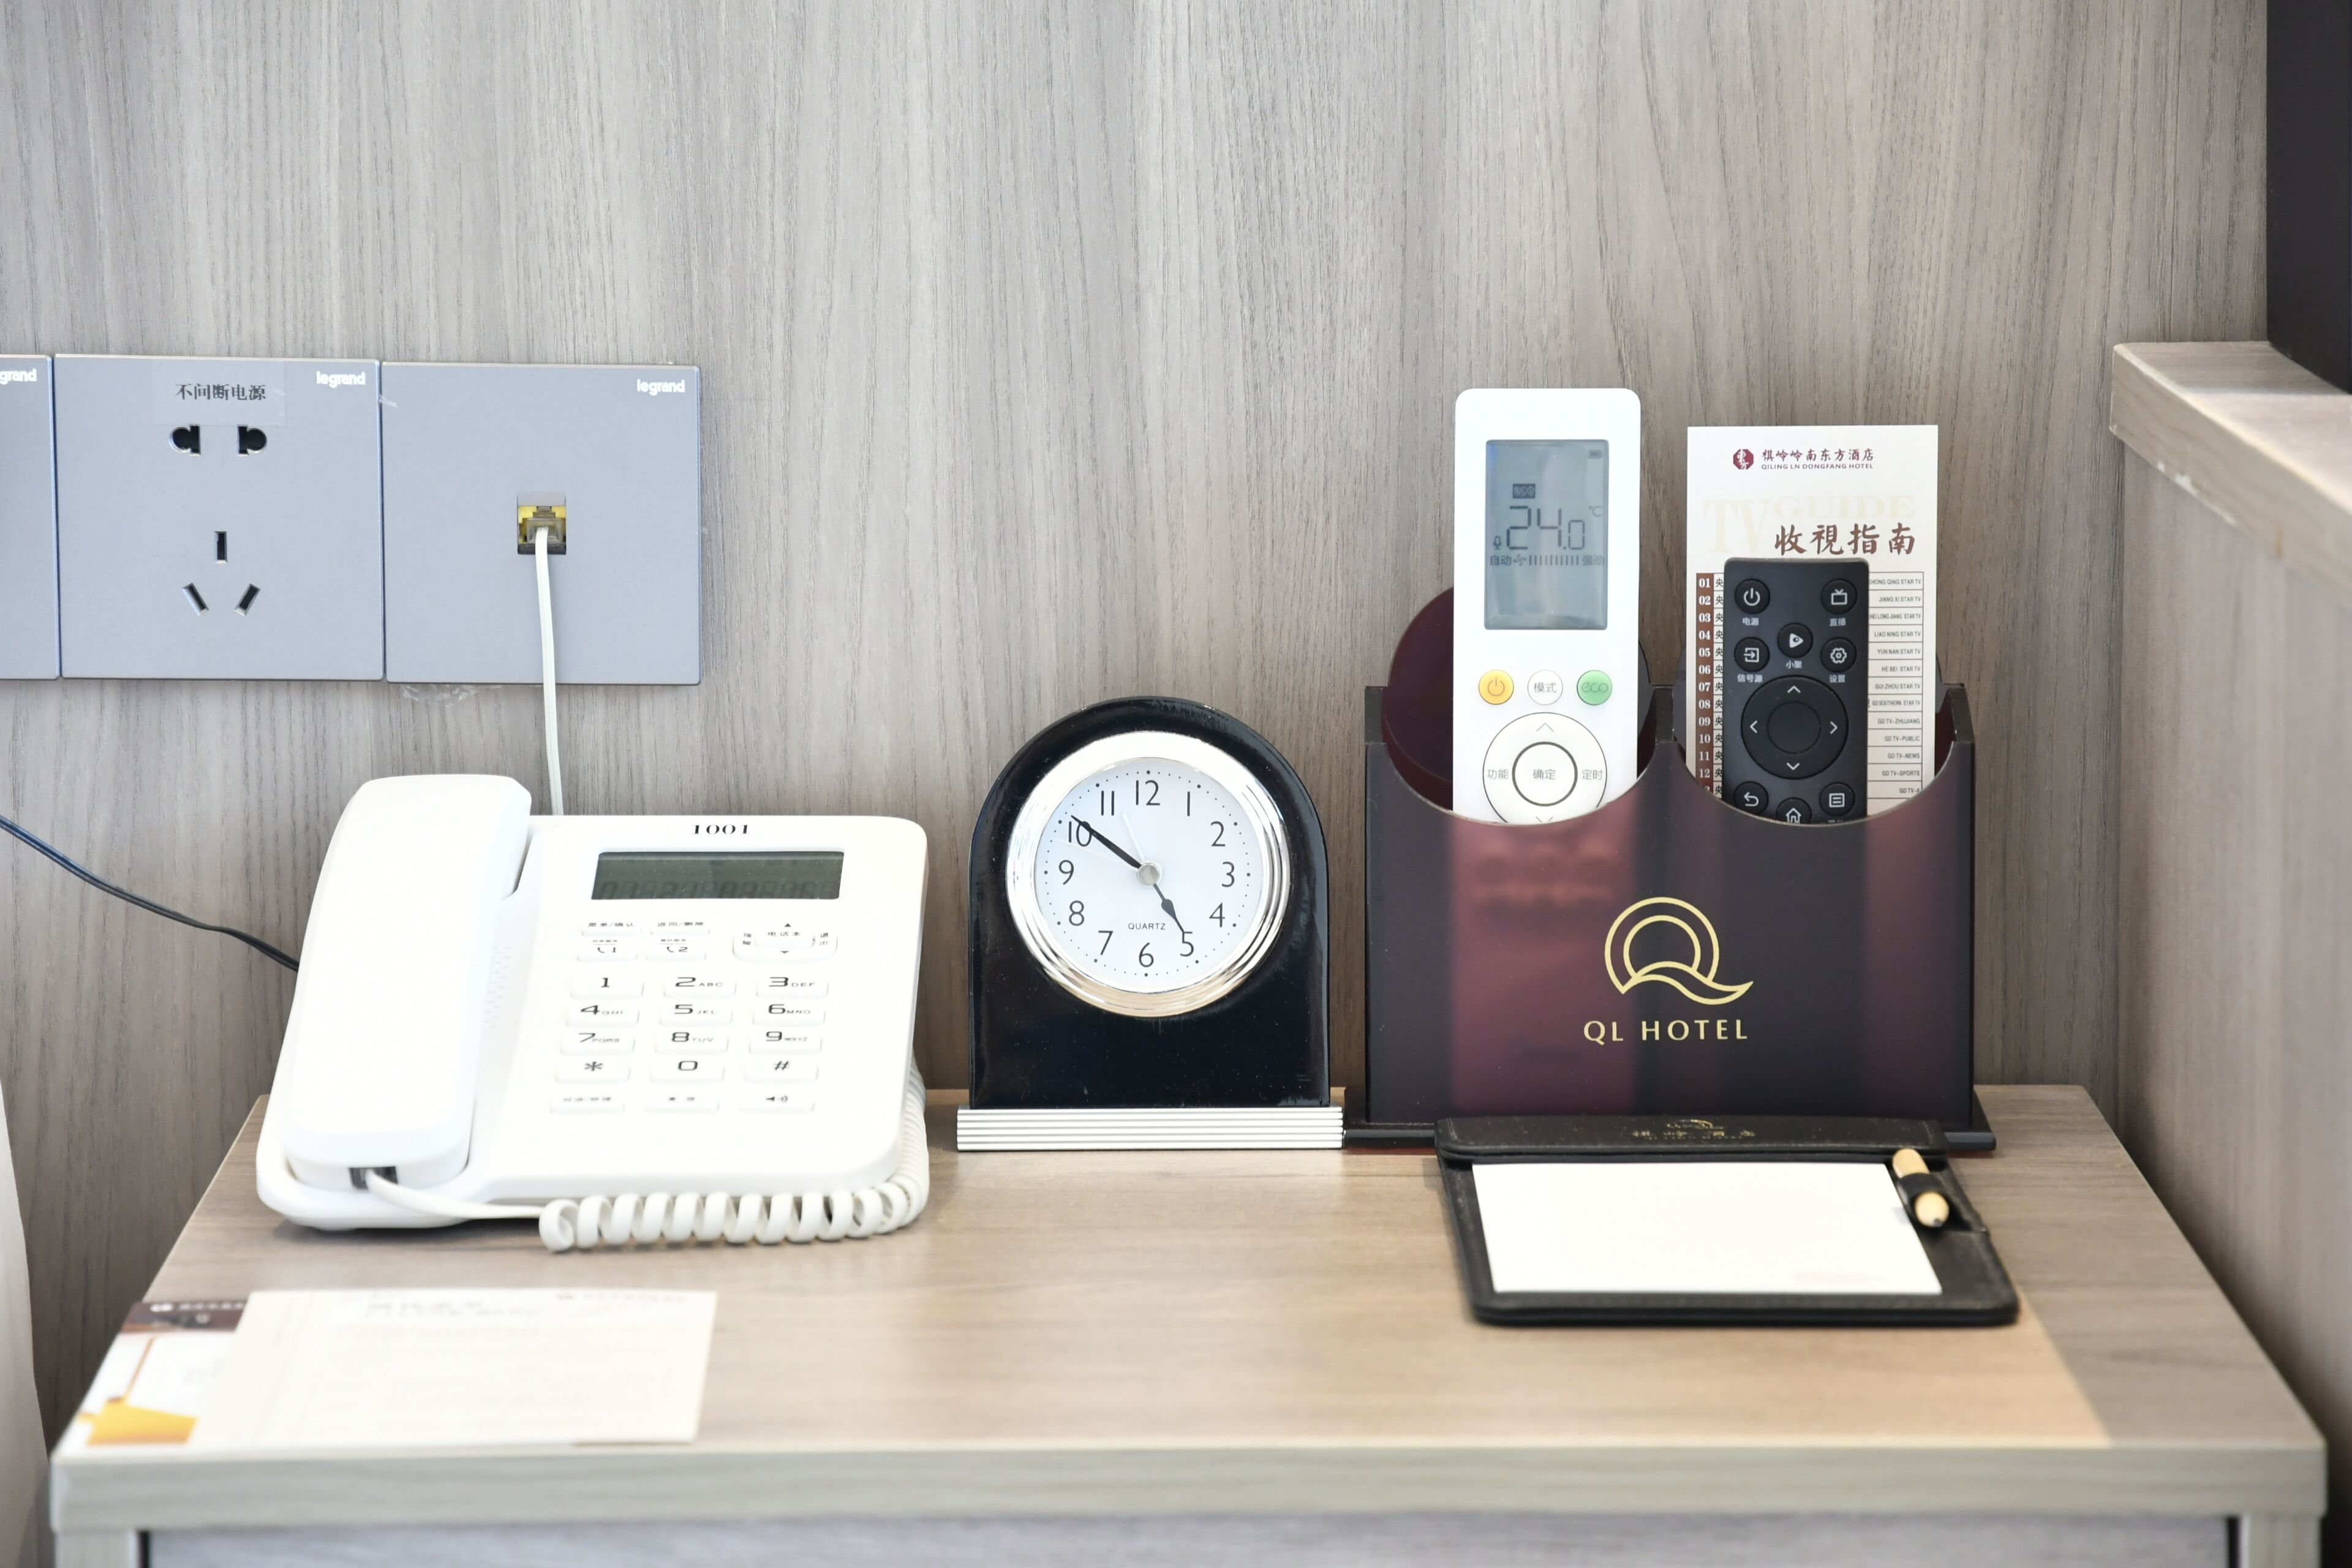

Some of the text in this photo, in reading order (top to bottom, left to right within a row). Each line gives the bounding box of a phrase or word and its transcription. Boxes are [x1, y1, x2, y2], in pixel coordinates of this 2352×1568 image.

[316, 371, 365, 388] legrand
[175, 384, 266, 401] 不间断电源
[636, 379, 685, 396] legrand
[1762, 448, 1874, 462] 棋岭岭南东方酒店
[1513, 484, 1536, 499] 制冷
[1506, 505, 1585, 550] 24.0
[1703, 495, 1916, 554] TV GUIDE
[1774, 522, 1915, 556] 收視指南
[1490, 555, 1512, 566] 自动
[1582, 555, 1605, 567] 强劲
[1698, 578, 1711, 588] 01
[1698, 595, 1711, 605] 02
[1698, 612, 1711, 623] 03
[1698, 630, 1711, 640] 04
[1698, 647, 1711, 657] 05
[1698, 665, 1711, 674] 06
[1737, 674, 1763, 684] 信号源
[1829, 674, 1846, 684] 设置
[1534, 682, 1557, 693] 模式
[1581, 682, 1608, 693] eco
[1698, 682, 1711, 692] 07
[1698, 699, 1711, 709] 08
[1698, 717, 1711, 726] 09
[1698, 734, 1711, 744] 10
[1698, 751, 1710, 761] 11
[1487, 769, 1509, 780] 功能
[1532, 769, 1556, 780] 确定
[1581, 769, 1603, 781] 定时
[1698, 768, 1711, 778] 12
[1136, 780, 1161, 805] 12
[1101, 790, 1115, 816] 11
[1186, 791, 1191, 816] 1
[691, 824, 751, 835] 1001
[1068, 821, 1093, 846] 10
[1210, 821, 1226, 846] 2
[1058, 859, 1074, 885] 9
[1221, 861, 1235, 887] 3
[1068, 900, 1085, 926] 8
[1208, 902, 1226, 928] 4
[1098, 930, 1114, 956] 7
[1180, 930, 1194, 957] 5
[1138, 942, 1154, 967] 6
[600, 977, 610, 988] 1
[675, 977, 696, 987] 2
[769, 977, 789, 987] 3
[580, 1005, 600, 1015] 4
[674, 1004, 693, 1014] 5
[768, 1004, 786, 1014] 6
[578, 1033, 596, 1042] 7
[671, 1031, 690, 1042] 8
[766, 1031, 783, 1041] 9
[1583, 1019, 1747, 1045] QL HOTEL
